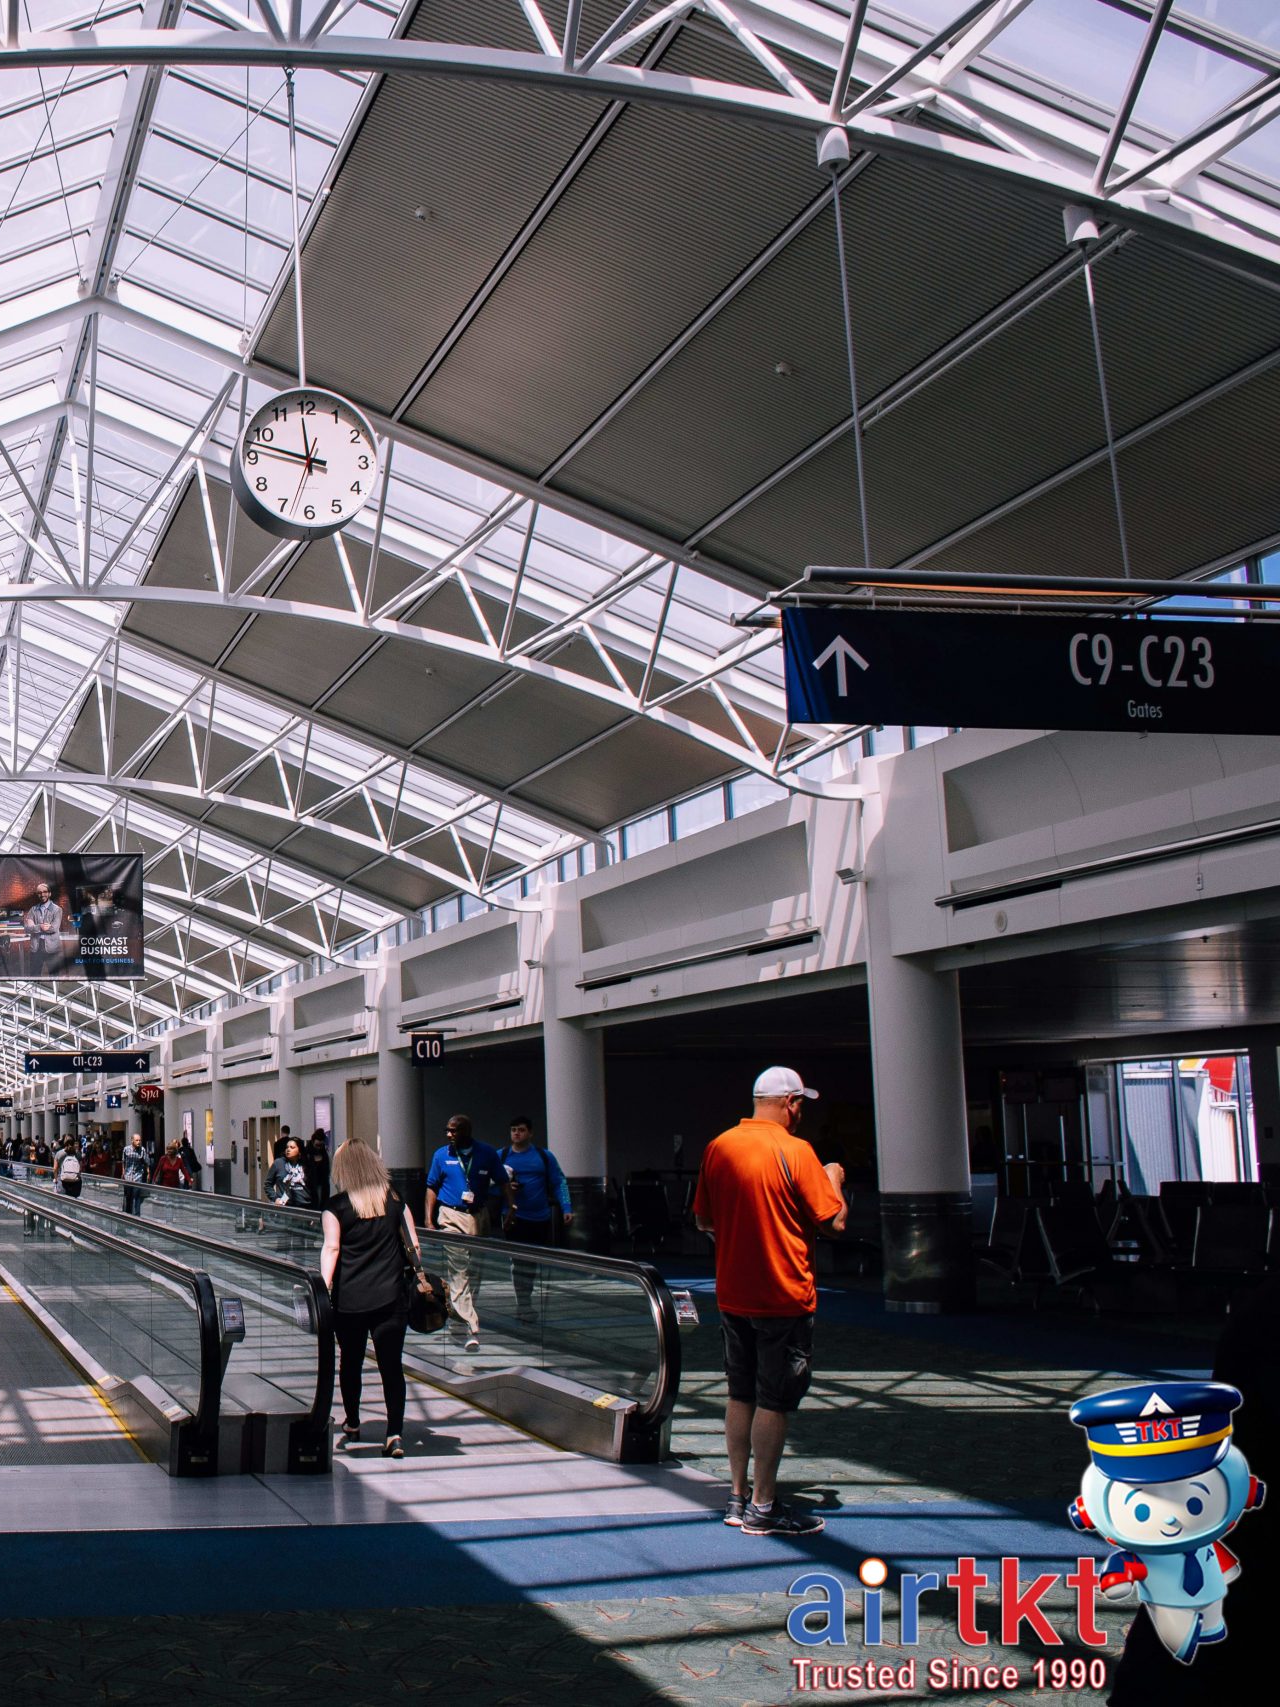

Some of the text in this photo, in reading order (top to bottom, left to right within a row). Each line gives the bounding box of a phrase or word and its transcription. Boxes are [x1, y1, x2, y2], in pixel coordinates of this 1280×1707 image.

[272, 407, 287, 422] 11
[297, 400, 316, 416] 12
[331, 409, 339, 424] 1
[253, 427, 274, 442] 10
[350, 429, 361, 444] 2
[247, 450, 258, 465] 9
[358, 455, 369, 470] 3
[255, 476, 268, 492] 8
[350, 481, 362, 495] 4
[277, 498, 288, 513] 7
[303, 505, 315, 520] 6
[331, 500, 342, 514] 5
[1070, 633, 1215, 689] C9-C23
[1127, 700, 1163, 718] Gates
[80, 937, 128, 946] COMCAST
[80, 946, 129, 955] BUSINESS
[416, 1040, 441, 1058] C10
[72, 1056, 103, 1066] C11-C23
[140, 1088, 160, 1103] Spa
